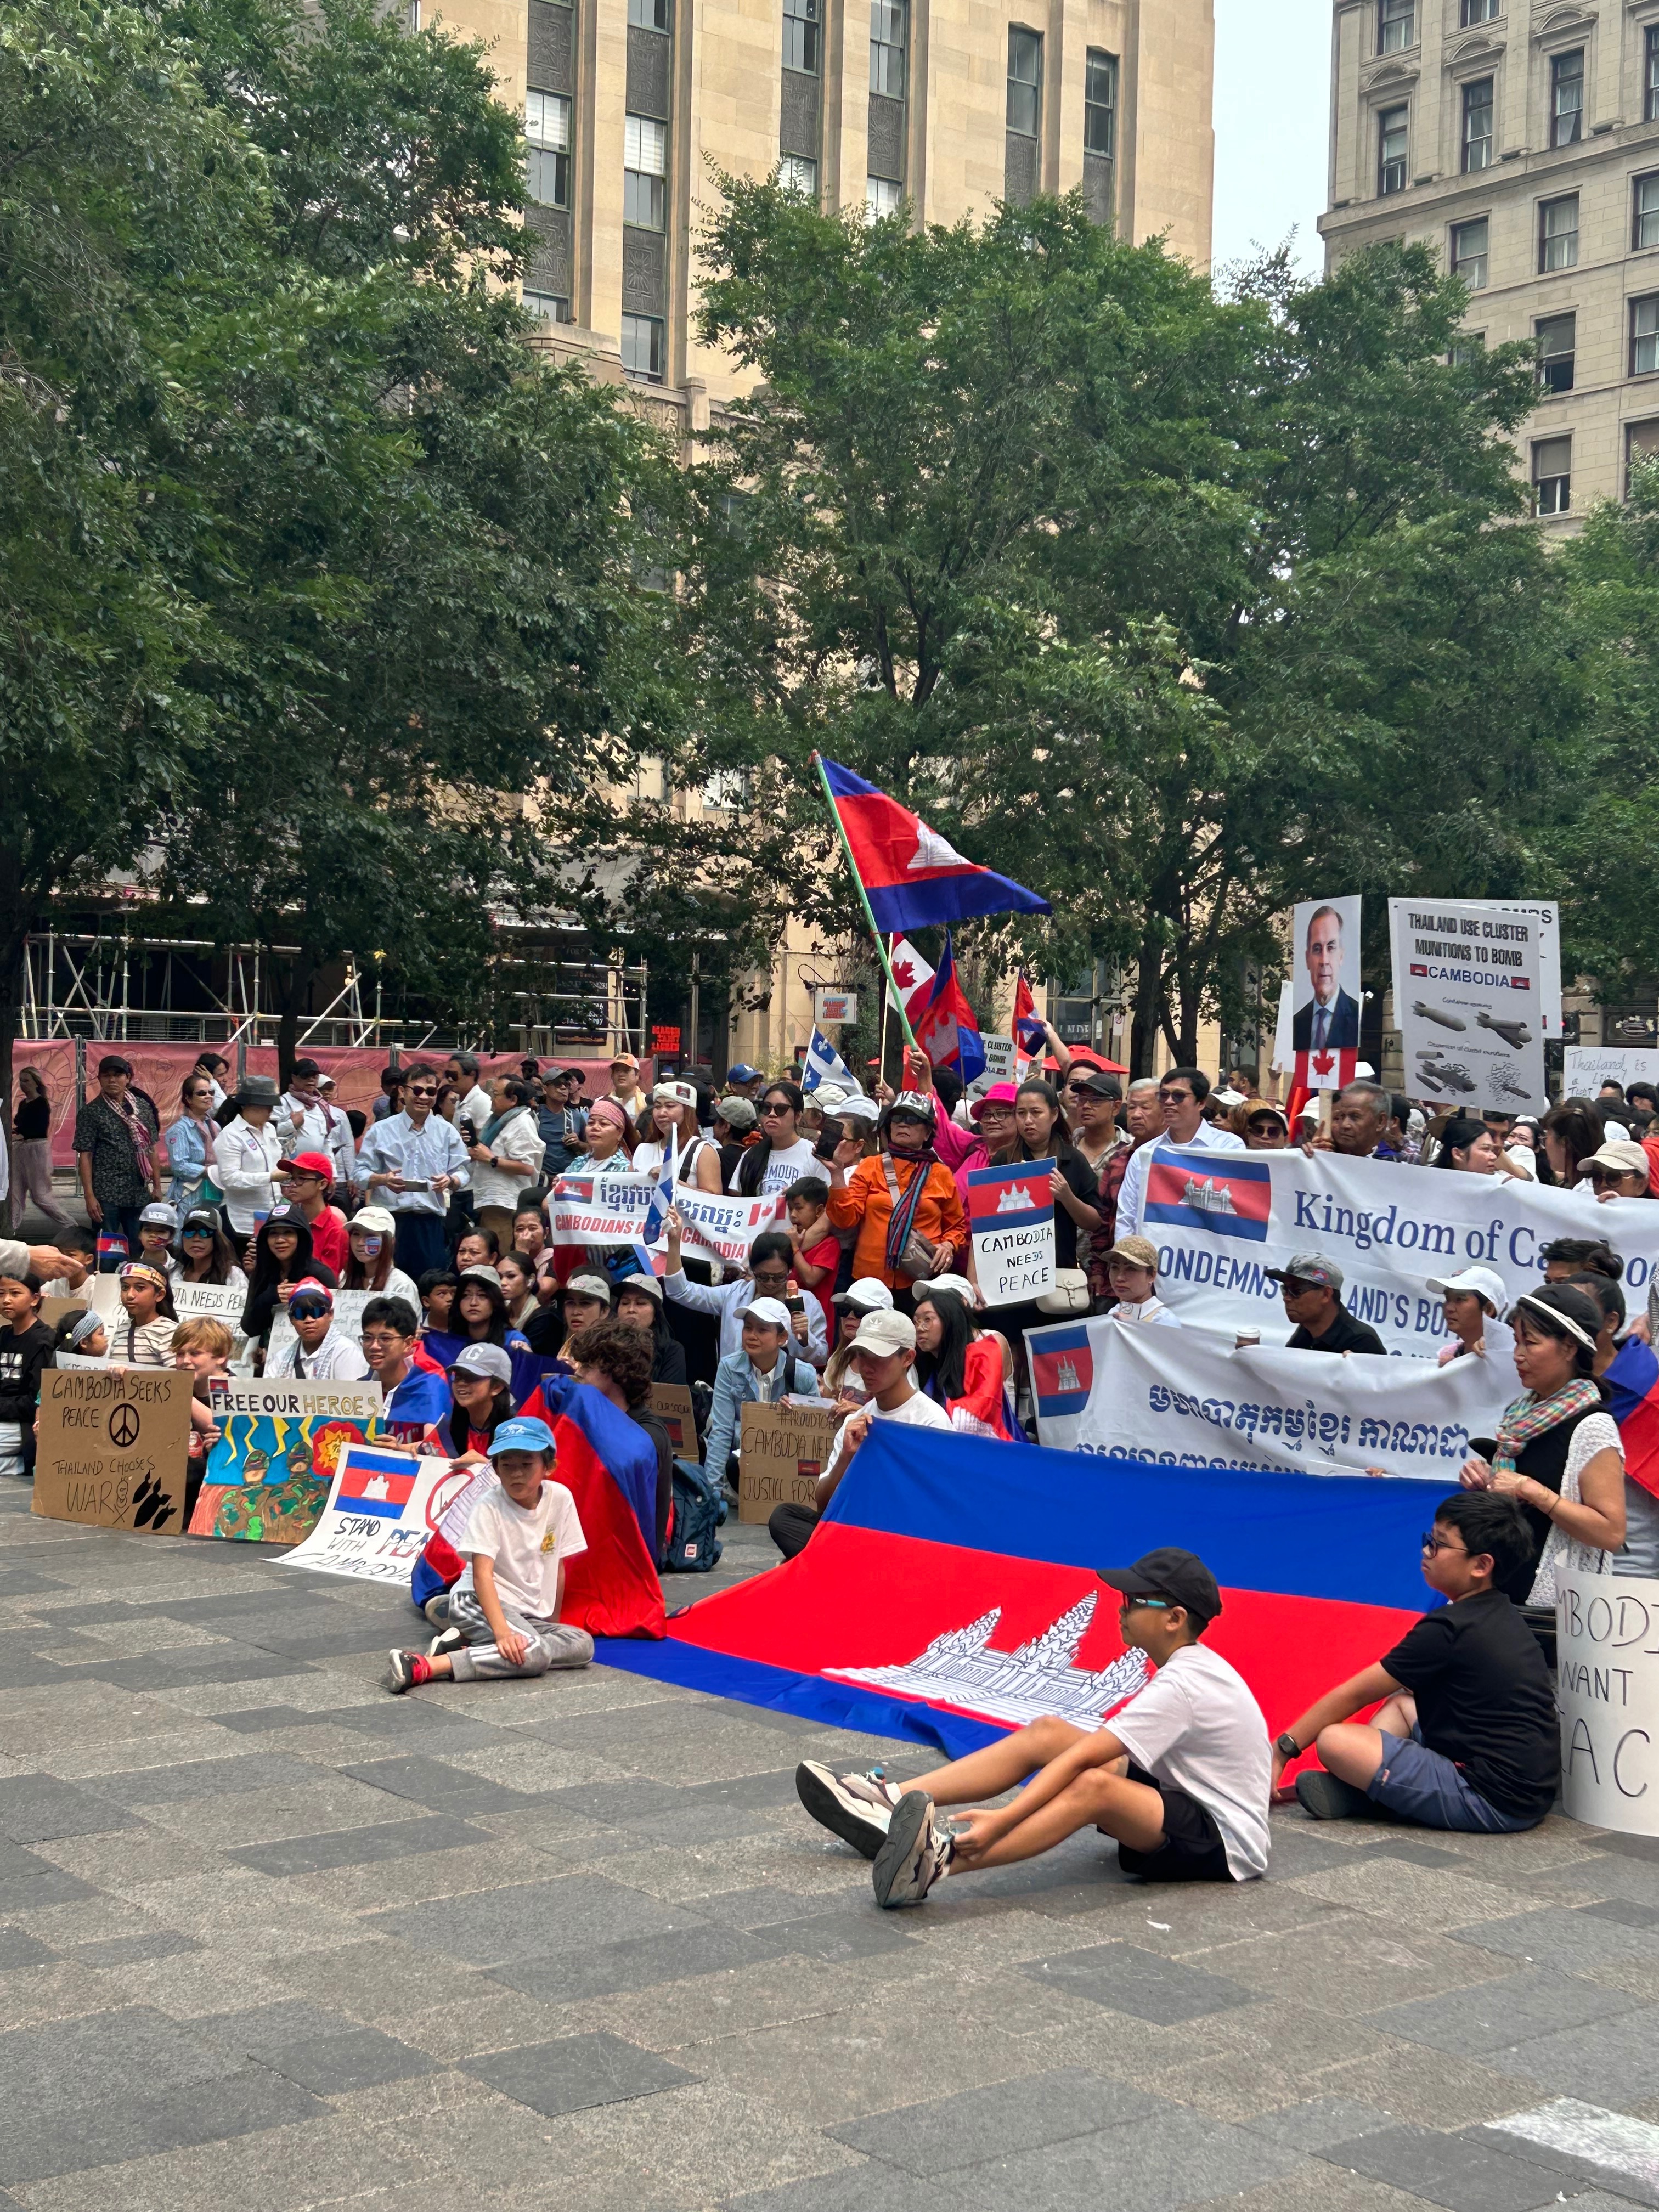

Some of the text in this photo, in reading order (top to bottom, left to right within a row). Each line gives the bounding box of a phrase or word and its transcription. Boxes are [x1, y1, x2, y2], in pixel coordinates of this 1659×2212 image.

[1408, 913, 1528, 942] THAILAND USE CLUSTER
[1415, 939, 1523, 967] MUNITIONS TO BOMB
[1429, 966, 1510, 988] CAMBODIA
[555, 1214, 634, 1234] CAMBODIANS
[1294, 1190, 1456, 1255] Kingdom
[1465, 1219, 1504, 1262] of
[981, 1228, 1053, 1253] CAMBODIA
[1007, 1250, 1043, 1268] NEEDS
[999, 1267, 1049, 1294] PEACE
[1157, 1245, 1279, 1299] ONDEMNS
[191, 1290, 225, 1308] NEEDS
[52, 1375, 171, 1403] CAMBODIA SEEKS
[63, 1406, 99, 1428] PEACE
[212, 1393, 379, 1418] FREE OUR HEROES
[742, 1427, 806, 1459] CAMBODIA
[52, 1455, 155, 1476] THAILAND CHOOSES
[67, 1480, 115, 1514] WAR
[792, 1479, 816, 1503] FOR
[334, 1517, 381, 1537] STAND
[327, 1537, 368, 1552] WITH
